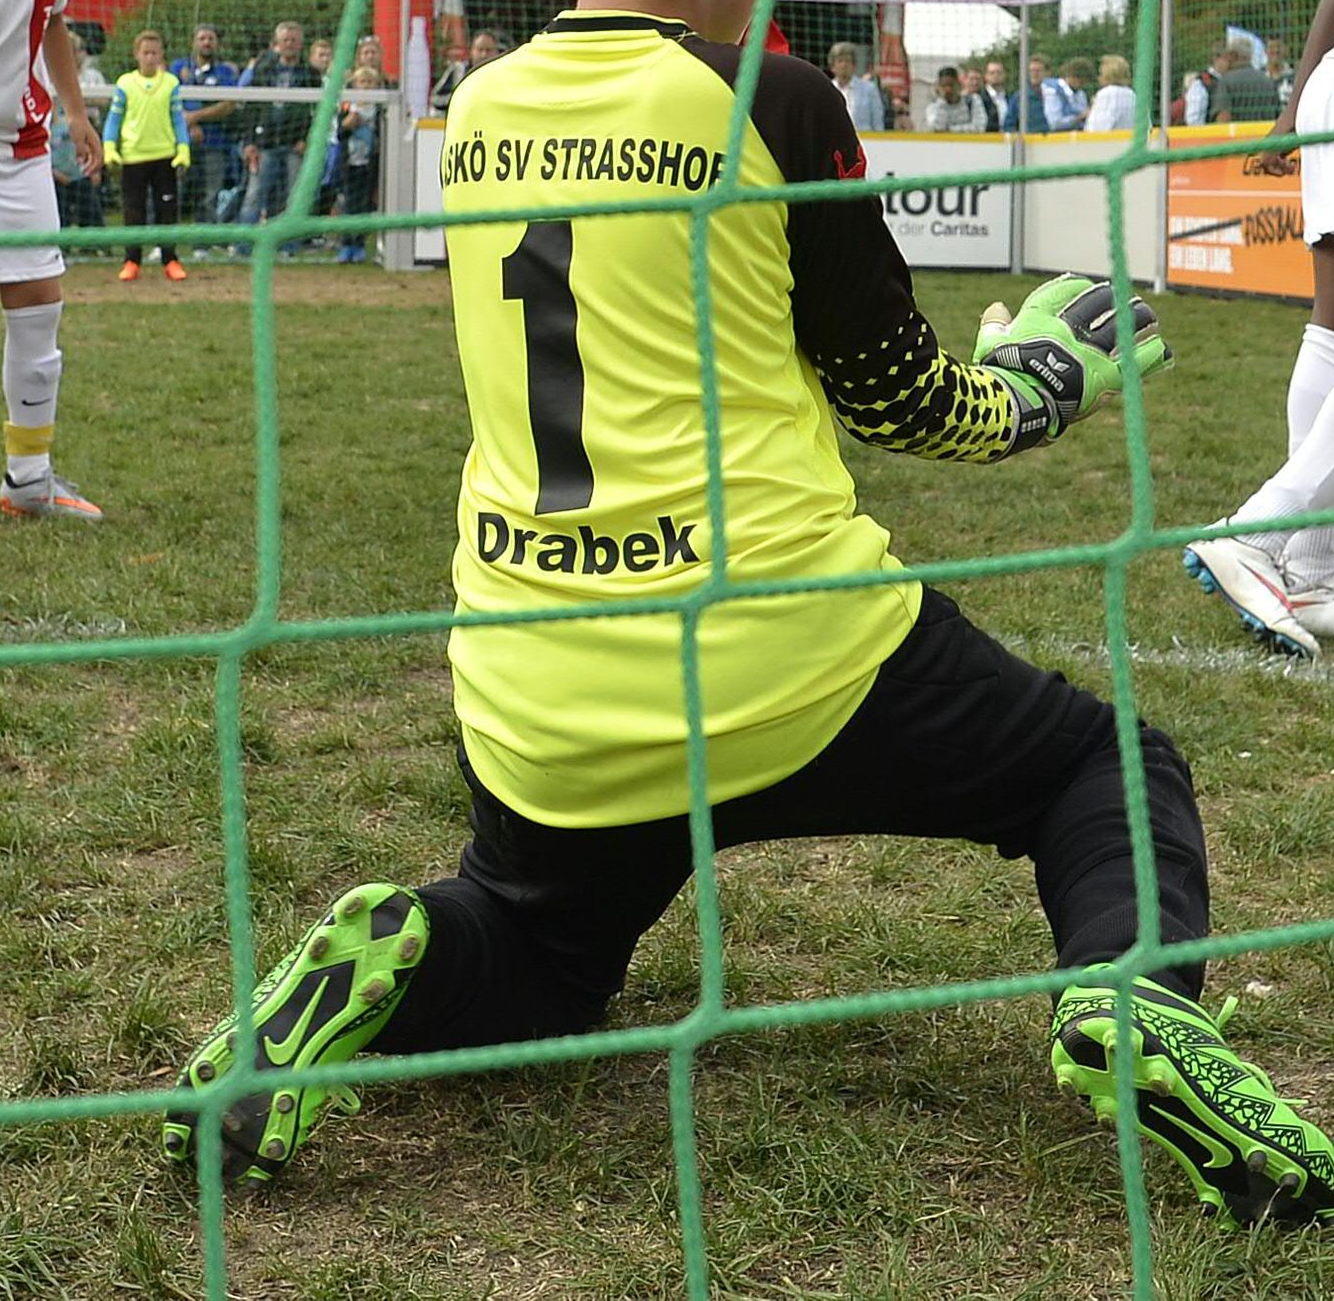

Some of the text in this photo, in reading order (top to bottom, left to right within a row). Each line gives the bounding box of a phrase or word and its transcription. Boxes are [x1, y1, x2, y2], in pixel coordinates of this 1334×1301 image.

[495, 139, 534, 181] SV
[930, 220, 990, 237] Caritas
[502, 219, 595, 516] 1
[1029, 358, 1065, 392] erima
[477, 512, 702, 575] Drabek
